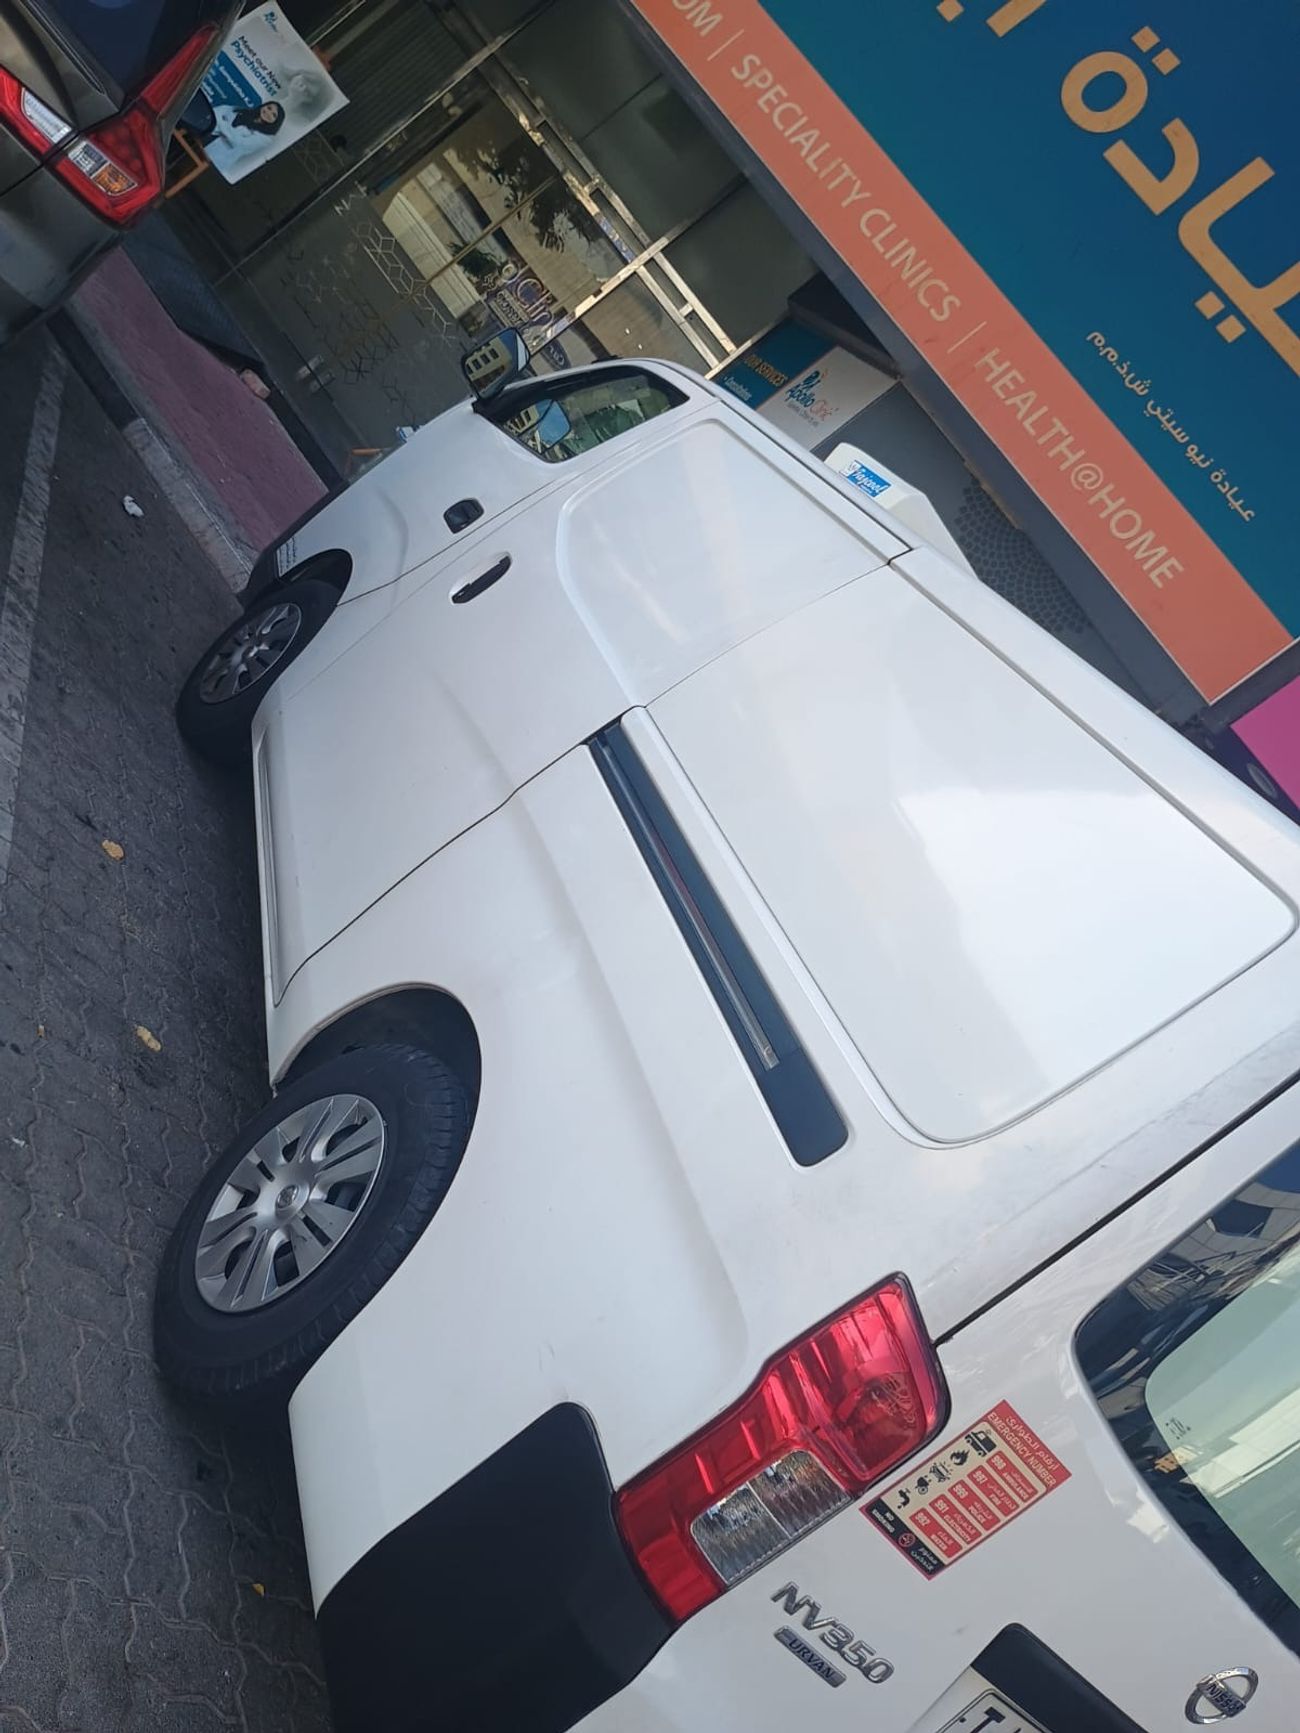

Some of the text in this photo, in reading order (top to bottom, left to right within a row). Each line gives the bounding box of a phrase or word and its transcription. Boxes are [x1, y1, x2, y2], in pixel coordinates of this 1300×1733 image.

[230, 40, 278, 97] Psychiatrist
[238, 35, 281, 90] Meet our New
[1060, 25, 1300, 377] يادة
[731, 53, 872, 208] SPECIALITY
[859, 207, 961, 322] CLINICS
[974, 347, 1185, 588] HEALTH@HOME
[1143, 400, 1190, 444] سيتي
[1185, 444, 1214, 468] نيو
[1210, 468, 1255, 521] عيادة
[987, 1412, 1057, 1486] EMERGENCY NUMBER
[770, 1580, 895, 1684] NV350
[788, 1637, 836, 1680] URVAN
